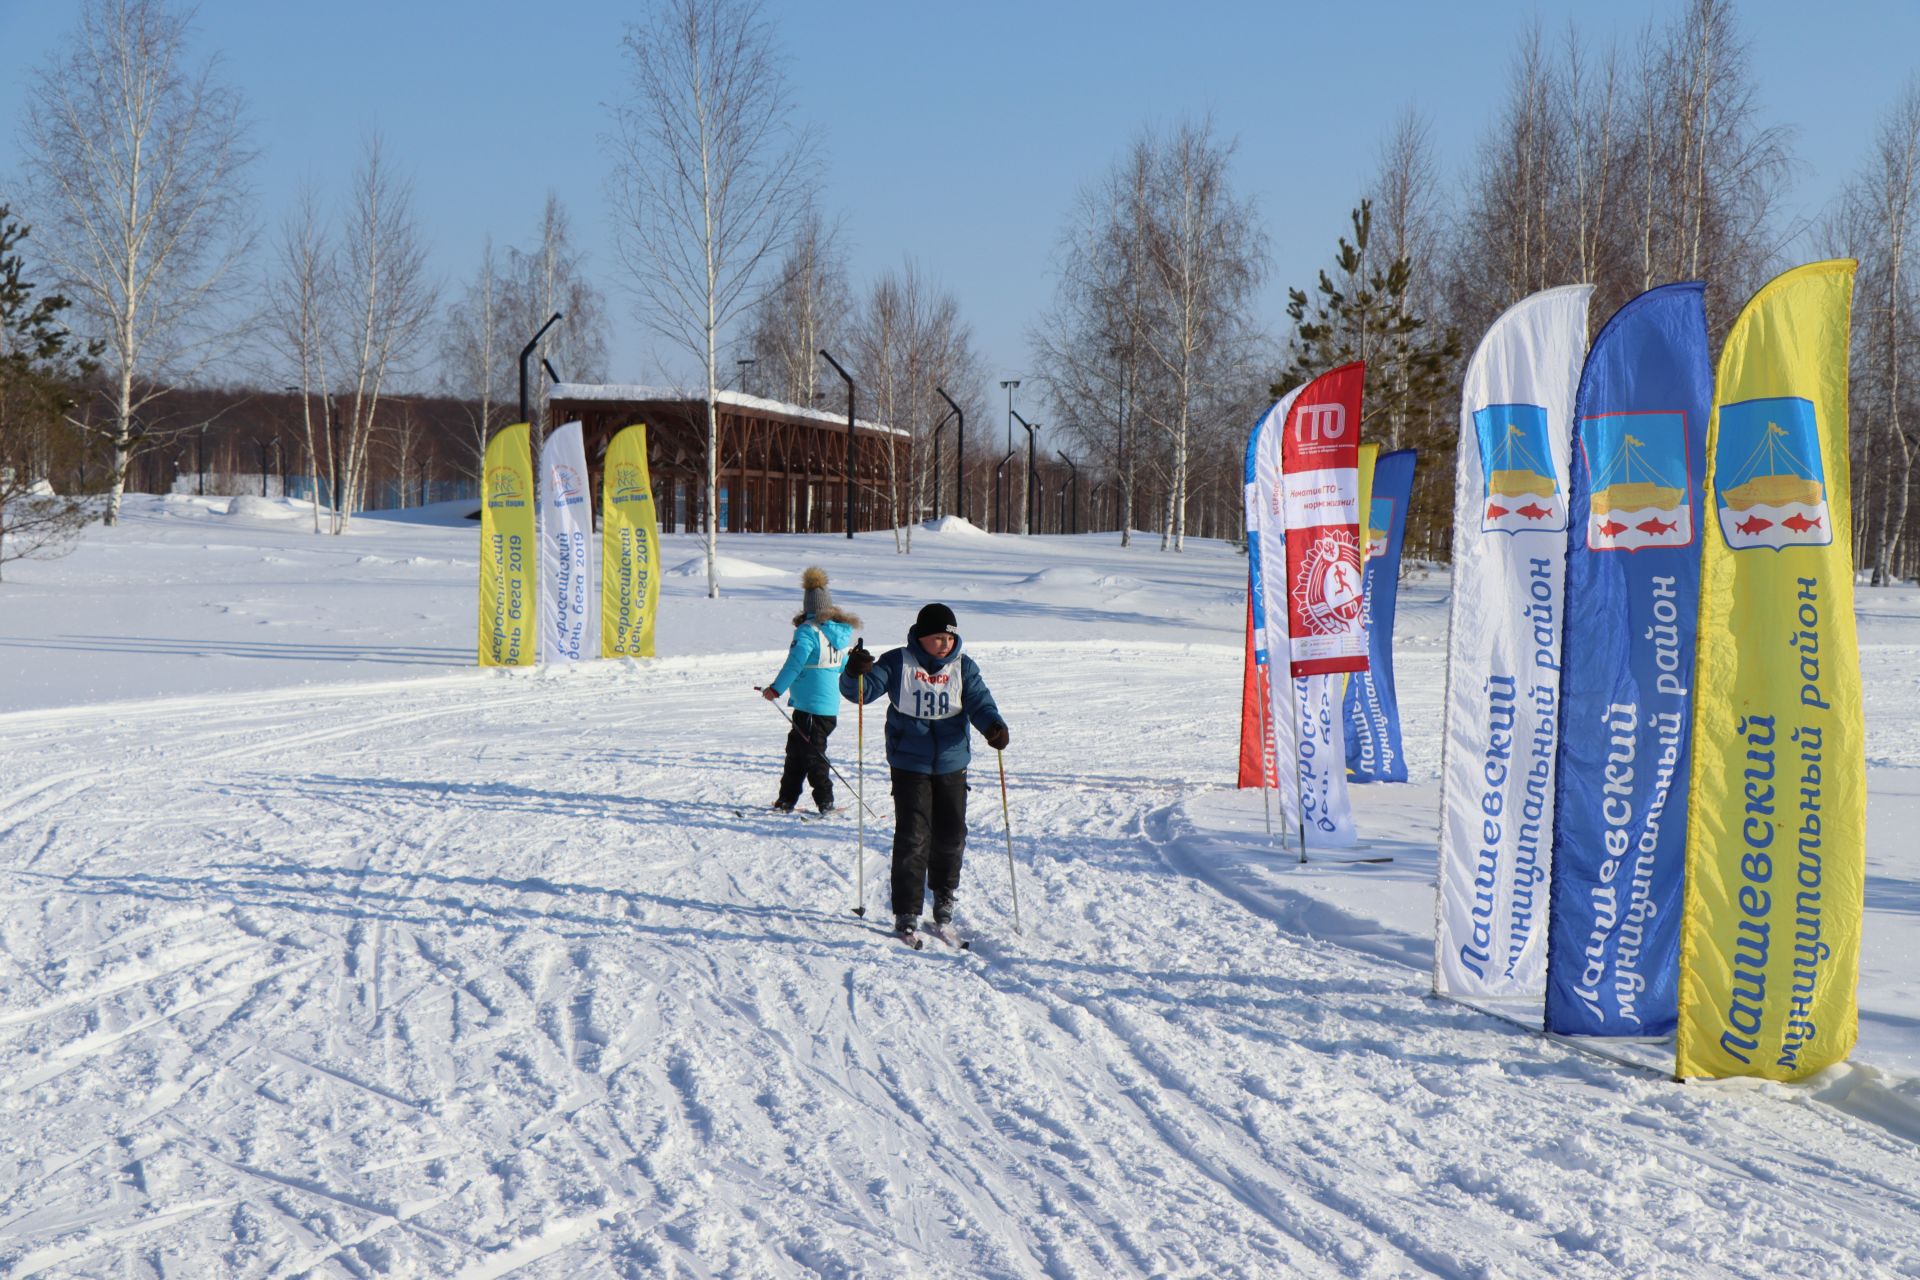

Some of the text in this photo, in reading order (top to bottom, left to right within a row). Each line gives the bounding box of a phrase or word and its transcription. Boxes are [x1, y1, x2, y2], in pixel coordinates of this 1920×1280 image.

[1295, 402, 1346, 442] ГТО
[505, 535, 522, 666] день бега 2019
[567, 532, 584, 660] день бега 2019
[614, 527, 632, 653] Всероссийский
[628, 528, 648, 654] день бега 2019
[1524, 557, 1561, 672] район
[912, 689, 950, 717] 138
[914, 671, 950, 684] РСФСР
[1460, 675, 1517, 979] Лаишевский
[1574, 701, 1638, 1023] Лаишевский
[1614, 575, 1688, 1025] муниципальный район
[1776, 577, 1831, 1070] муниципальный район
[1720, 714, 1777, 1064] Лаишевский
